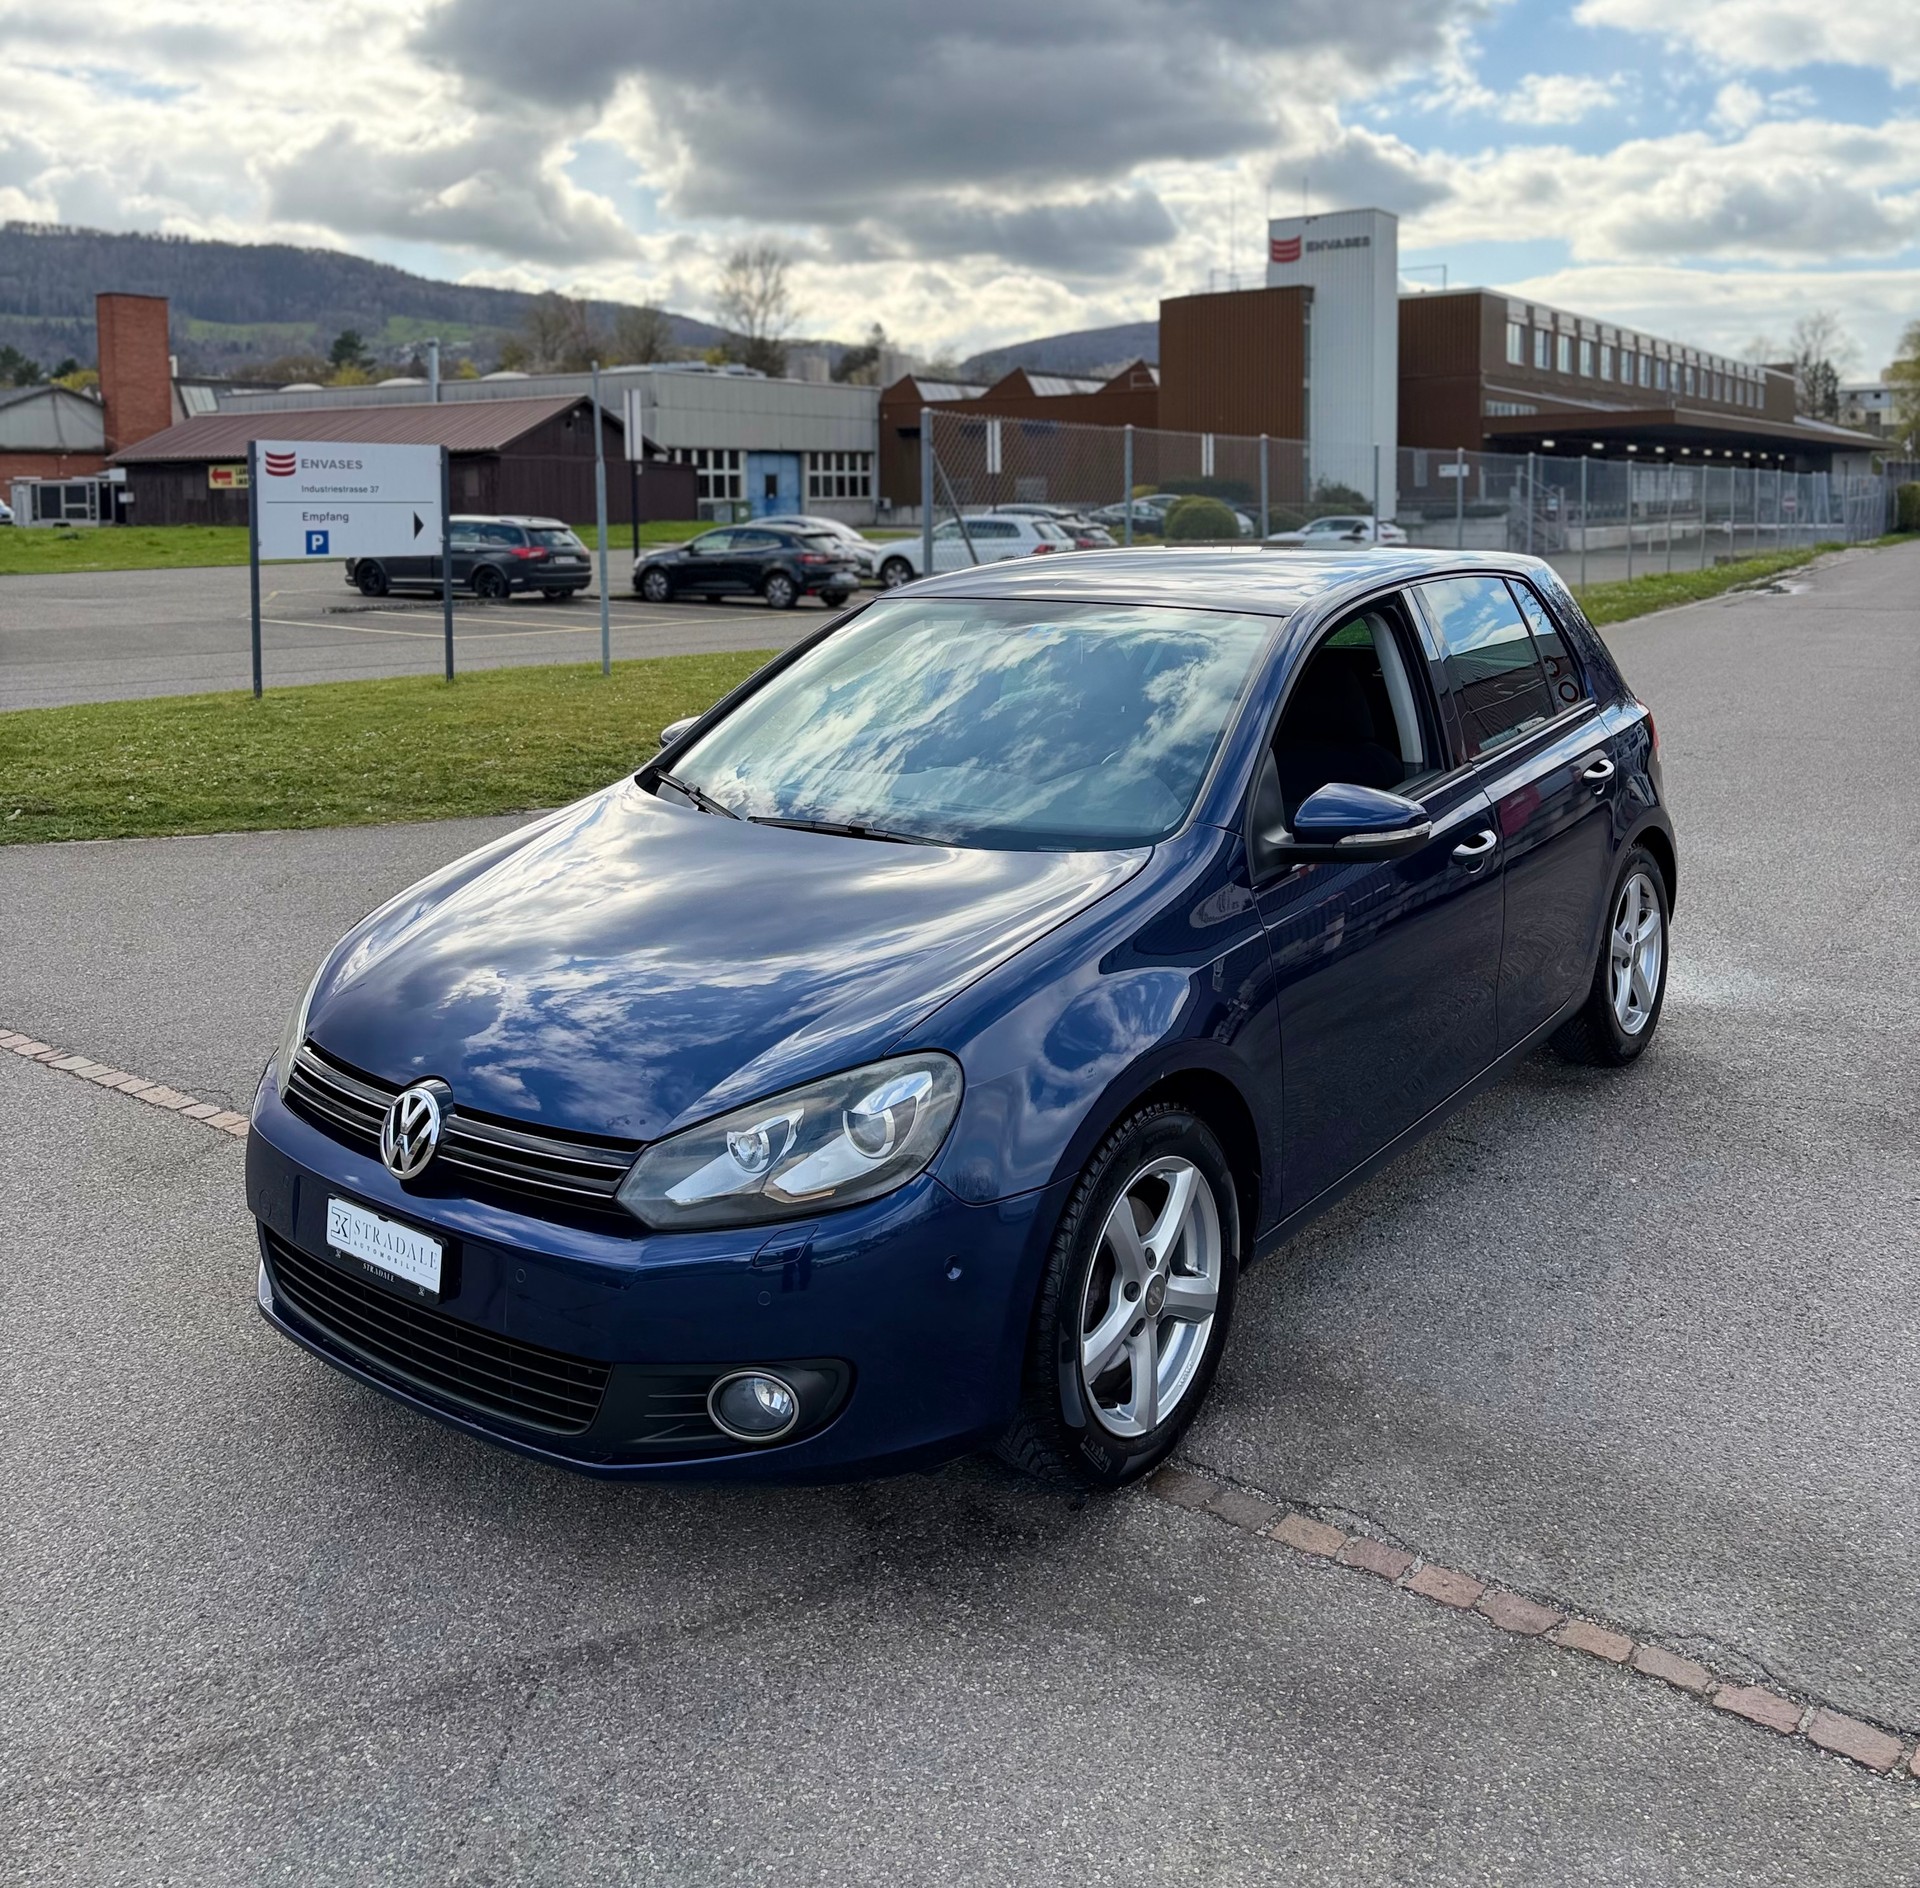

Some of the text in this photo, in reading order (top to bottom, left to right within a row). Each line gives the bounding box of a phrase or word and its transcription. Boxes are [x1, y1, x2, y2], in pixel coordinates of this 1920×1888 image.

[301, 458, 363, 470] ENVASES
[301, 485, 379, 493] Industriestrasse 37
[302, 512, 349, 523] Empfang
[311, 534, 324, 551] P
[353, 1219, 438, 1270] STRADALE
[362, 1262, 395, 1282] STRADALE
